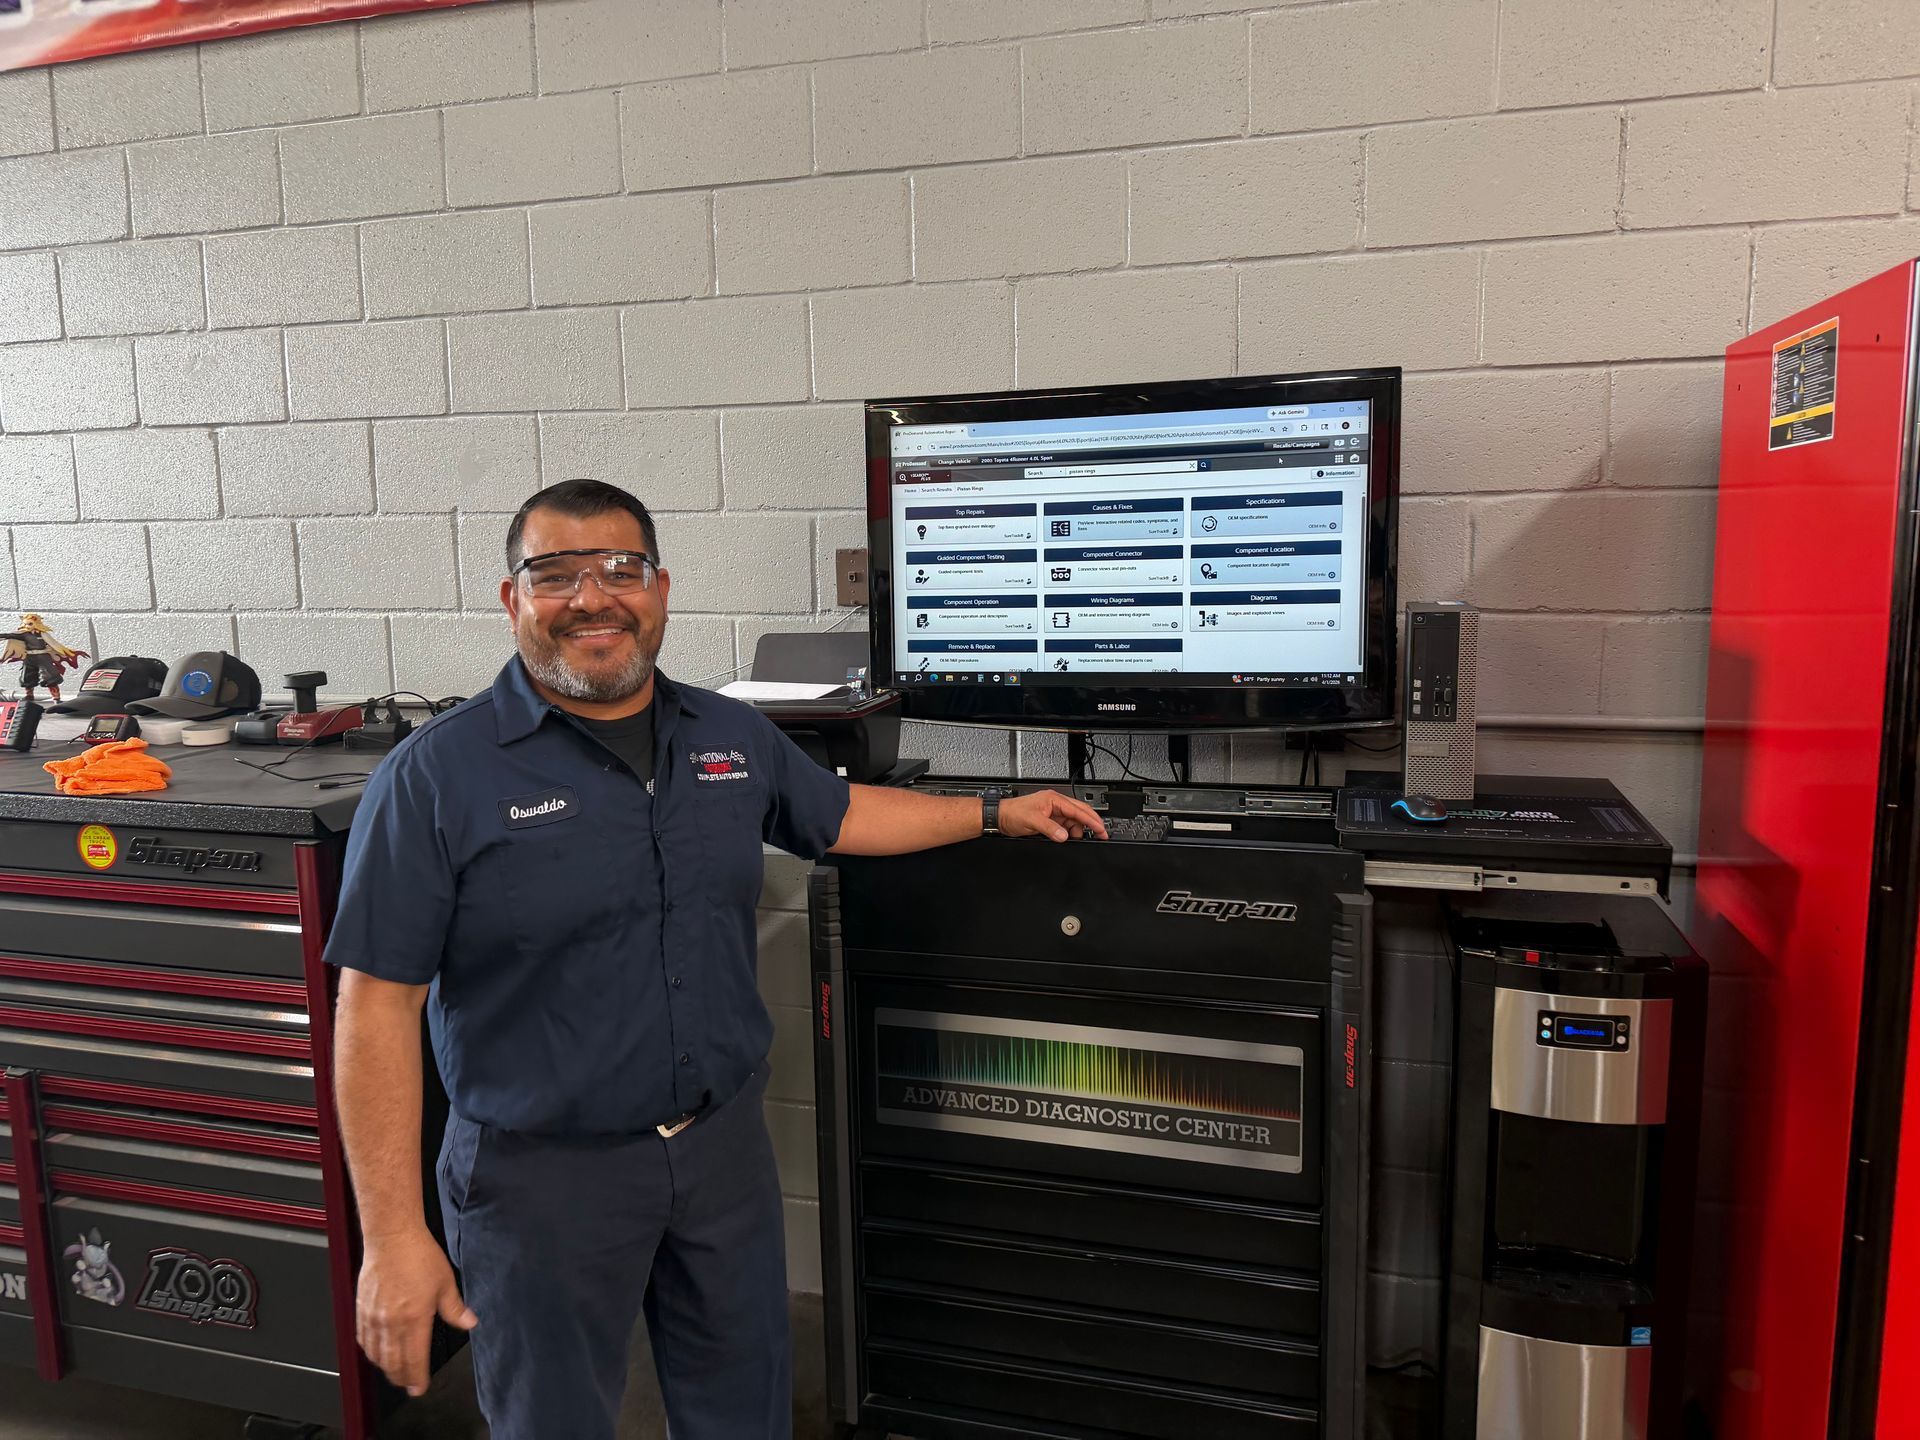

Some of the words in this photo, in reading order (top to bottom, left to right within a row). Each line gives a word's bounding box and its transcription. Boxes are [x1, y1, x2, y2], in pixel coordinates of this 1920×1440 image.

[1246, 497, 1285, 505] Specifications
[1097, 703, 1136, 711] SAMSUNG
[699, 752, 730, 764] NATIONAL
[510, 798, 567, 820] Oswaldo
[126, 836, 261, 874] Snap-on
[1156, 890, 1297, 921] Snap-on
[821, 981, 831, 1040] Snap-on
[1344, 1023, 1359, 1089] Snap-on
[903, 1086, 1019, 1114] ADVANCED
[1025, 1099, 1170, 1132] DIAGNOSTIC
[1175, 1117, 1271, 1145] CENTER
[148, 1289, 250, 1323] Snap-on
